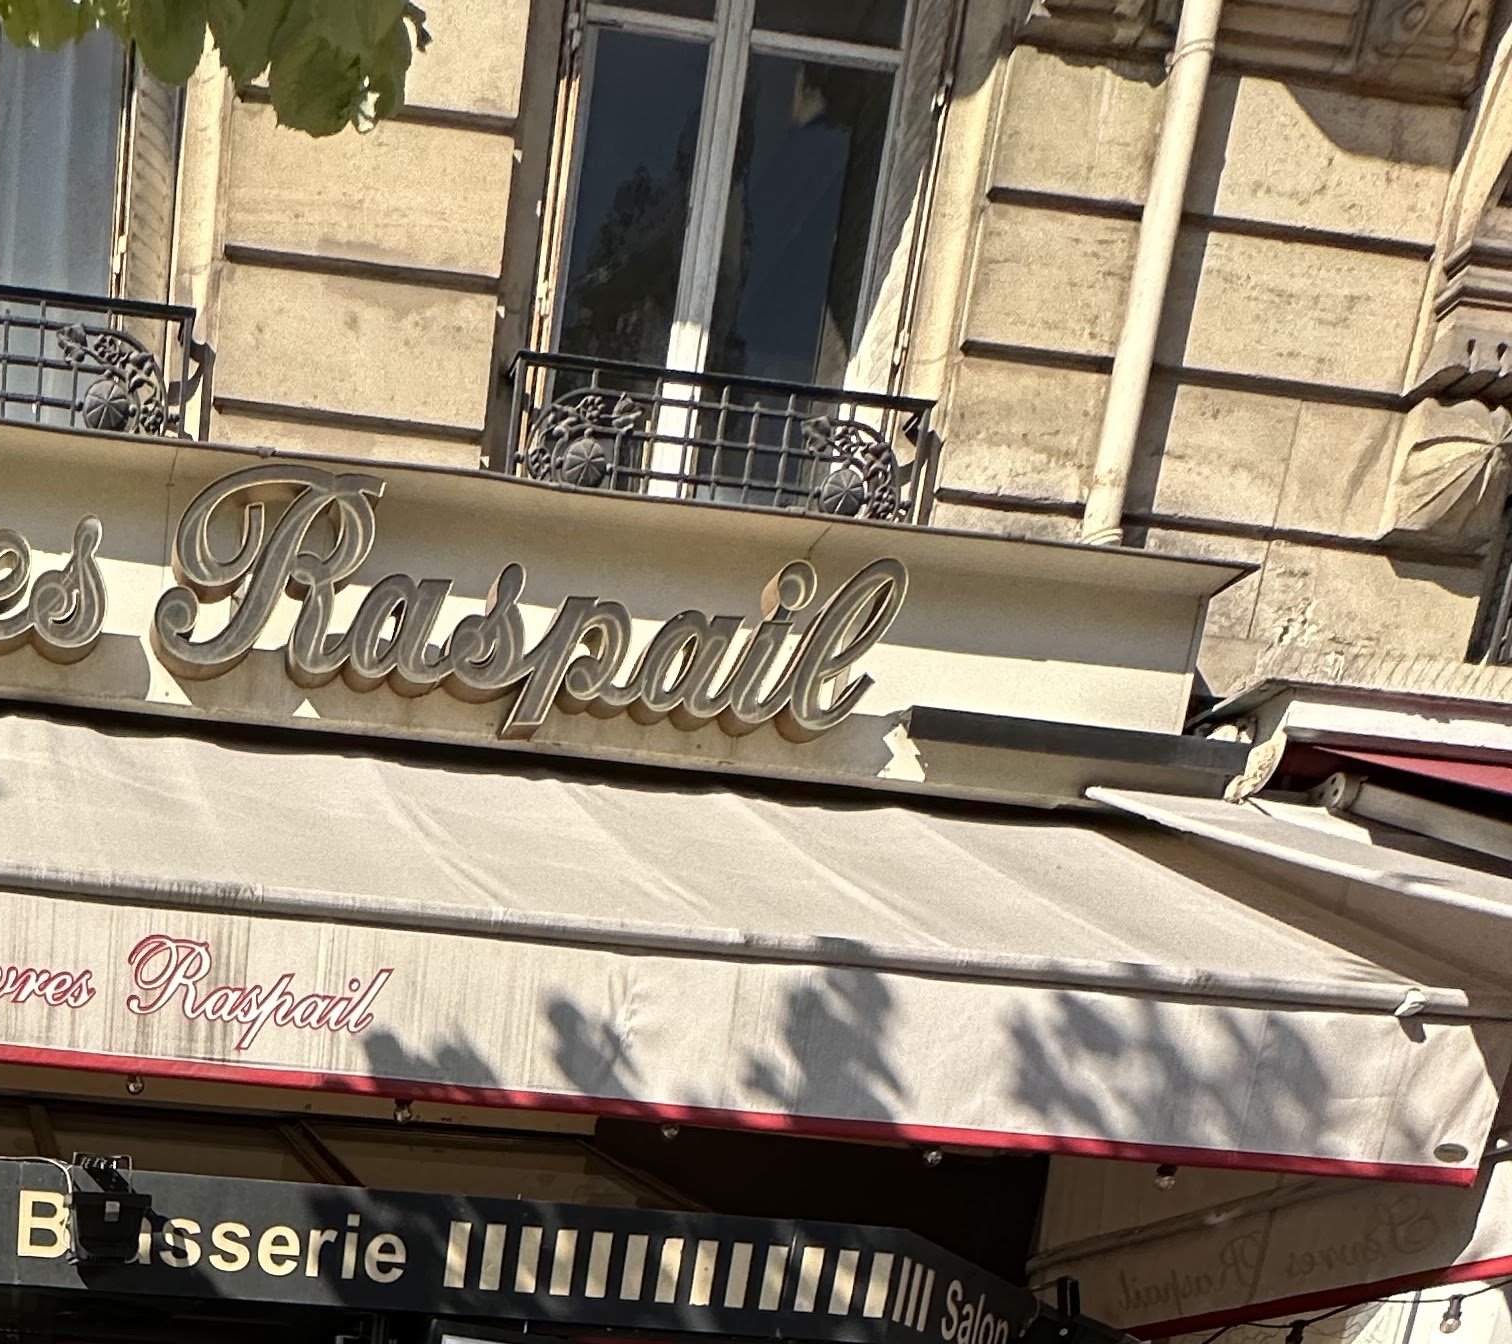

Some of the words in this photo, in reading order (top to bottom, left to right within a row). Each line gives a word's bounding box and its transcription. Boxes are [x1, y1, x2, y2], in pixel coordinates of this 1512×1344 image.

[150, 463, 908, 740] Raspail
[126, 934, 396, 1051] Raspail
[17, 1187, 409, 1285] Bsserie
